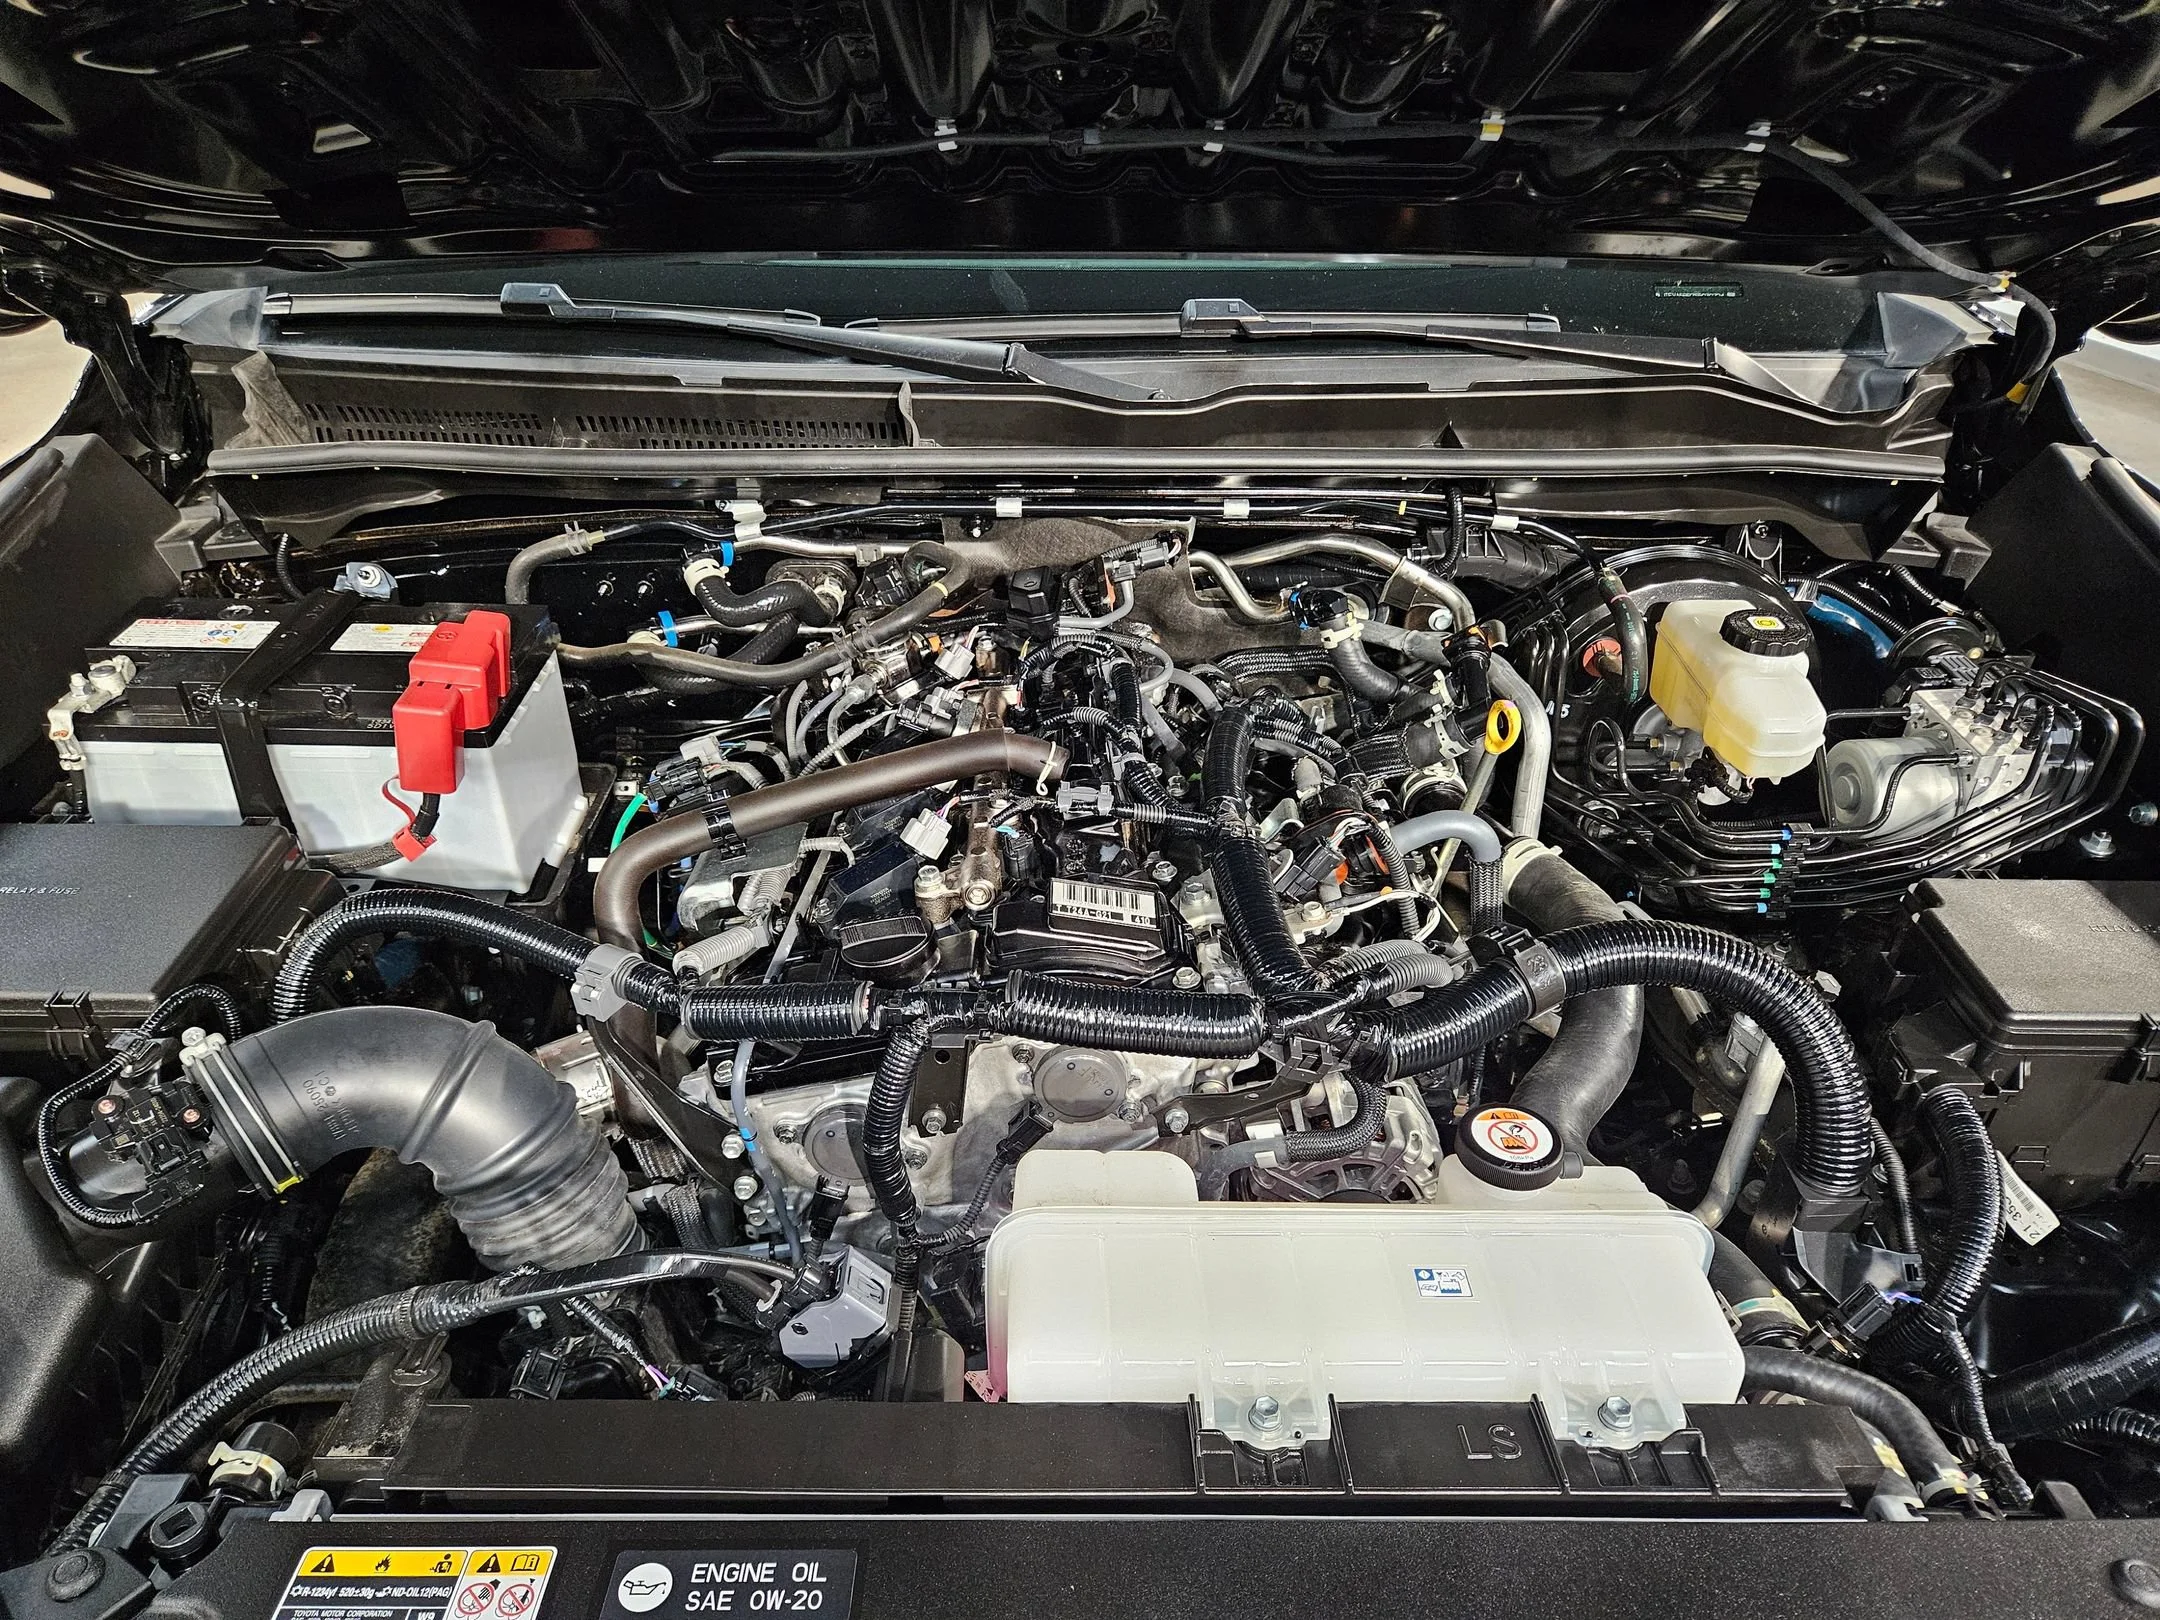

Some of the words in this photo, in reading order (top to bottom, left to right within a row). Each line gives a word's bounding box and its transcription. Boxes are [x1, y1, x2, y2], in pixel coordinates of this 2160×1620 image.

[0, 886, 37, 894] RELAY
[48, 887, 81, 895] FUSE
[1457, 1424, 1522, 1460] LS
[690, 1562, 777, 1583] ENGINE
[791, 1562, 827, 1583] OIL
[685, 1589, 735, 1612] SAE
[749, 1589, 823, 1612] 0W-20
[294, 1610, 319, 1618] TOYOTA
[320, 1610, 346, 1618] MOTOR
[346, 1610, 394, 1618] CORPORATION
